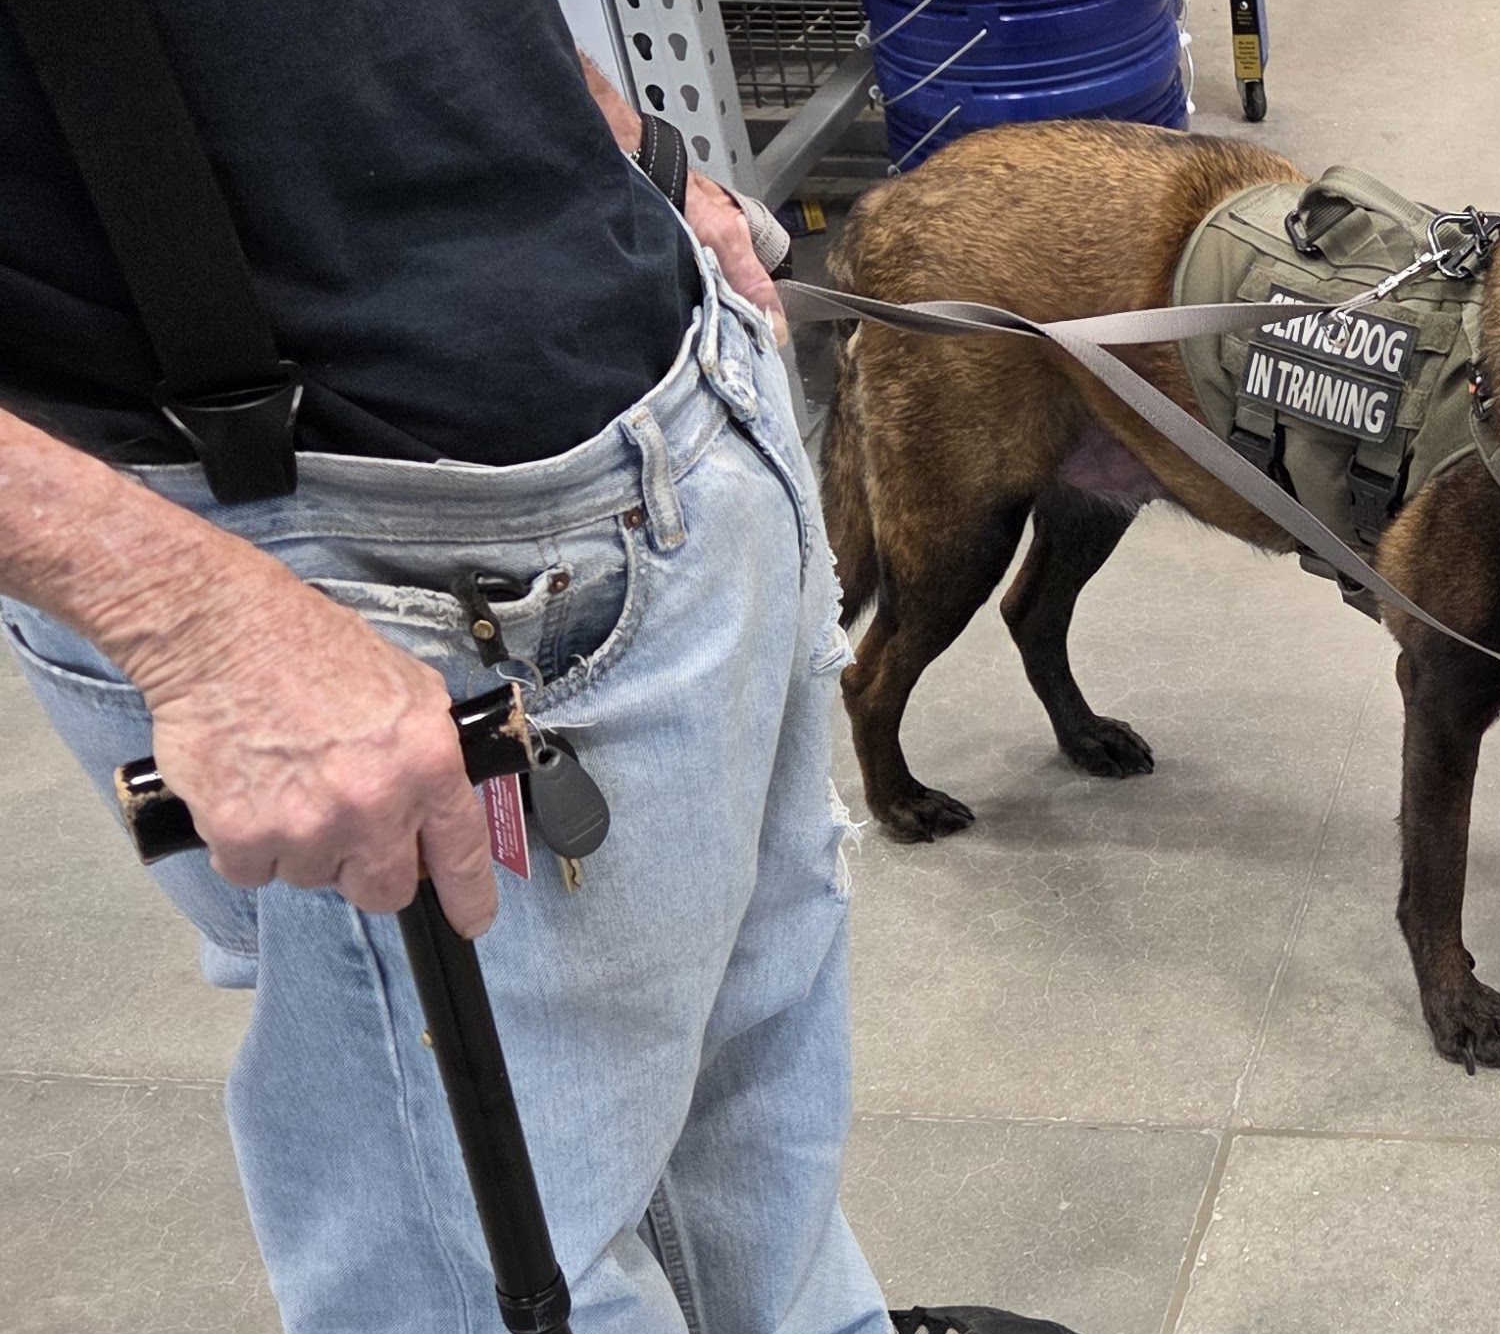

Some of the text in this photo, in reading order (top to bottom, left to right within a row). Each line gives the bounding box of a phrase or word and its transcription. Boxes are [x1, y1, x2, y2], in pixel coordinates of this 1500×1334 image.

[1345, 319, 1408, 373] DOG
[1246, 352, 1389, 434] IN TRAINING
